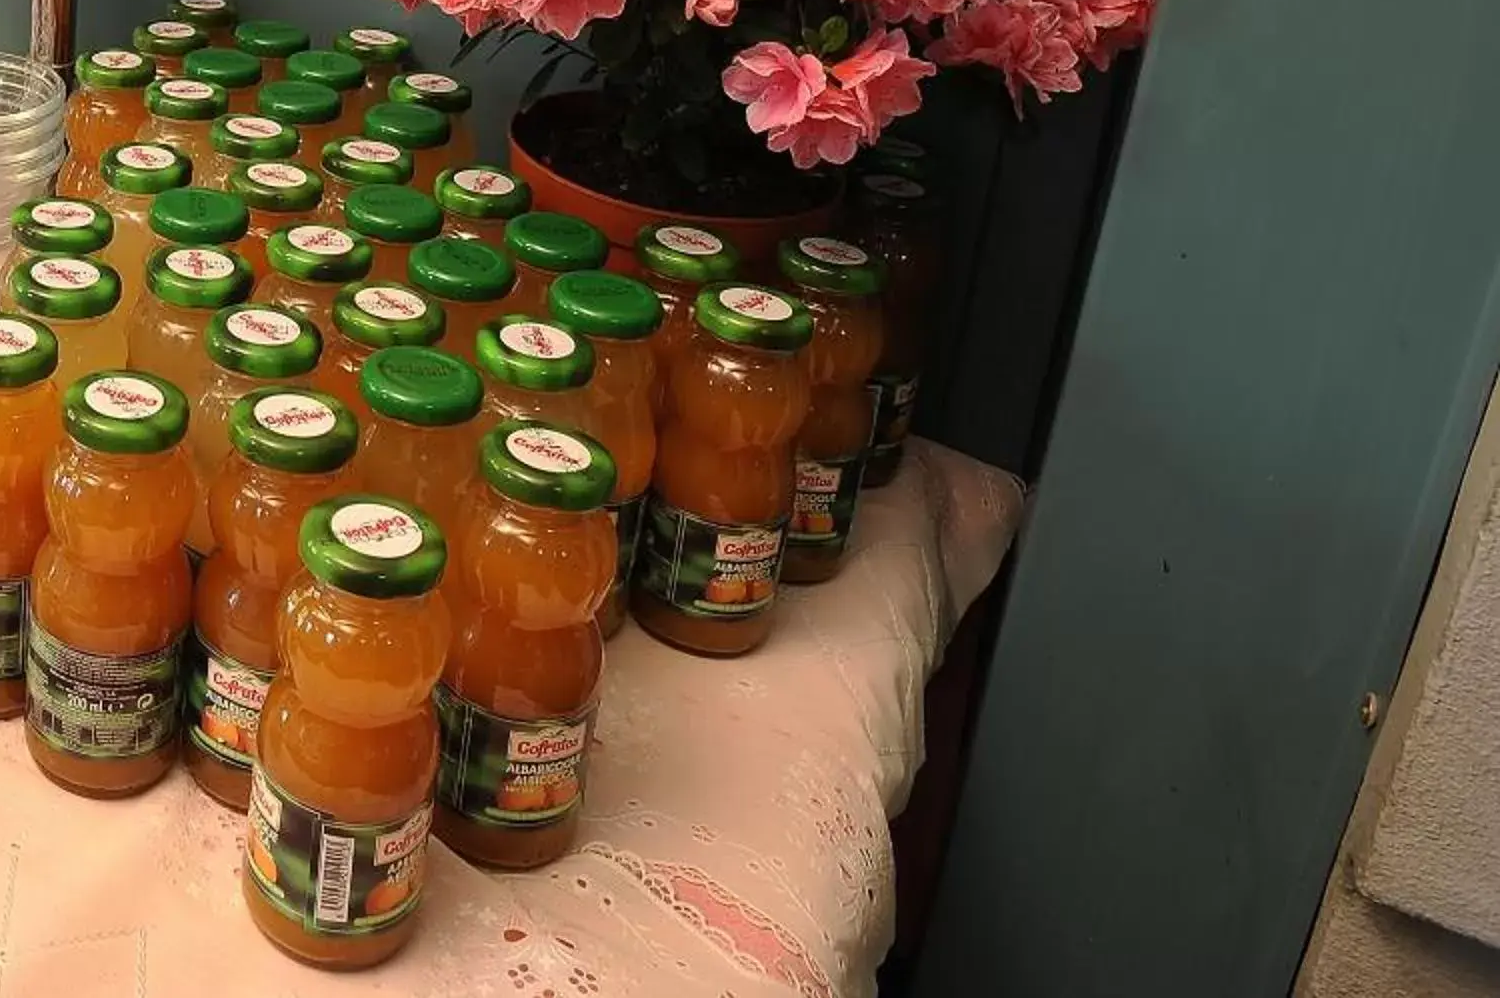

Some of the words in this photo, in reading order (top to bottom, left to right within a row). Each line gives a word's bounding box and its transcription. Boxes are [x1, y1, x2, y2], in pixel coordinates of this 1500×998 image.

[213, 671, 265, 704] Cofruto
[67, 693, 88, 711] 200
[517, 739, 579, 758] Cofrutos
